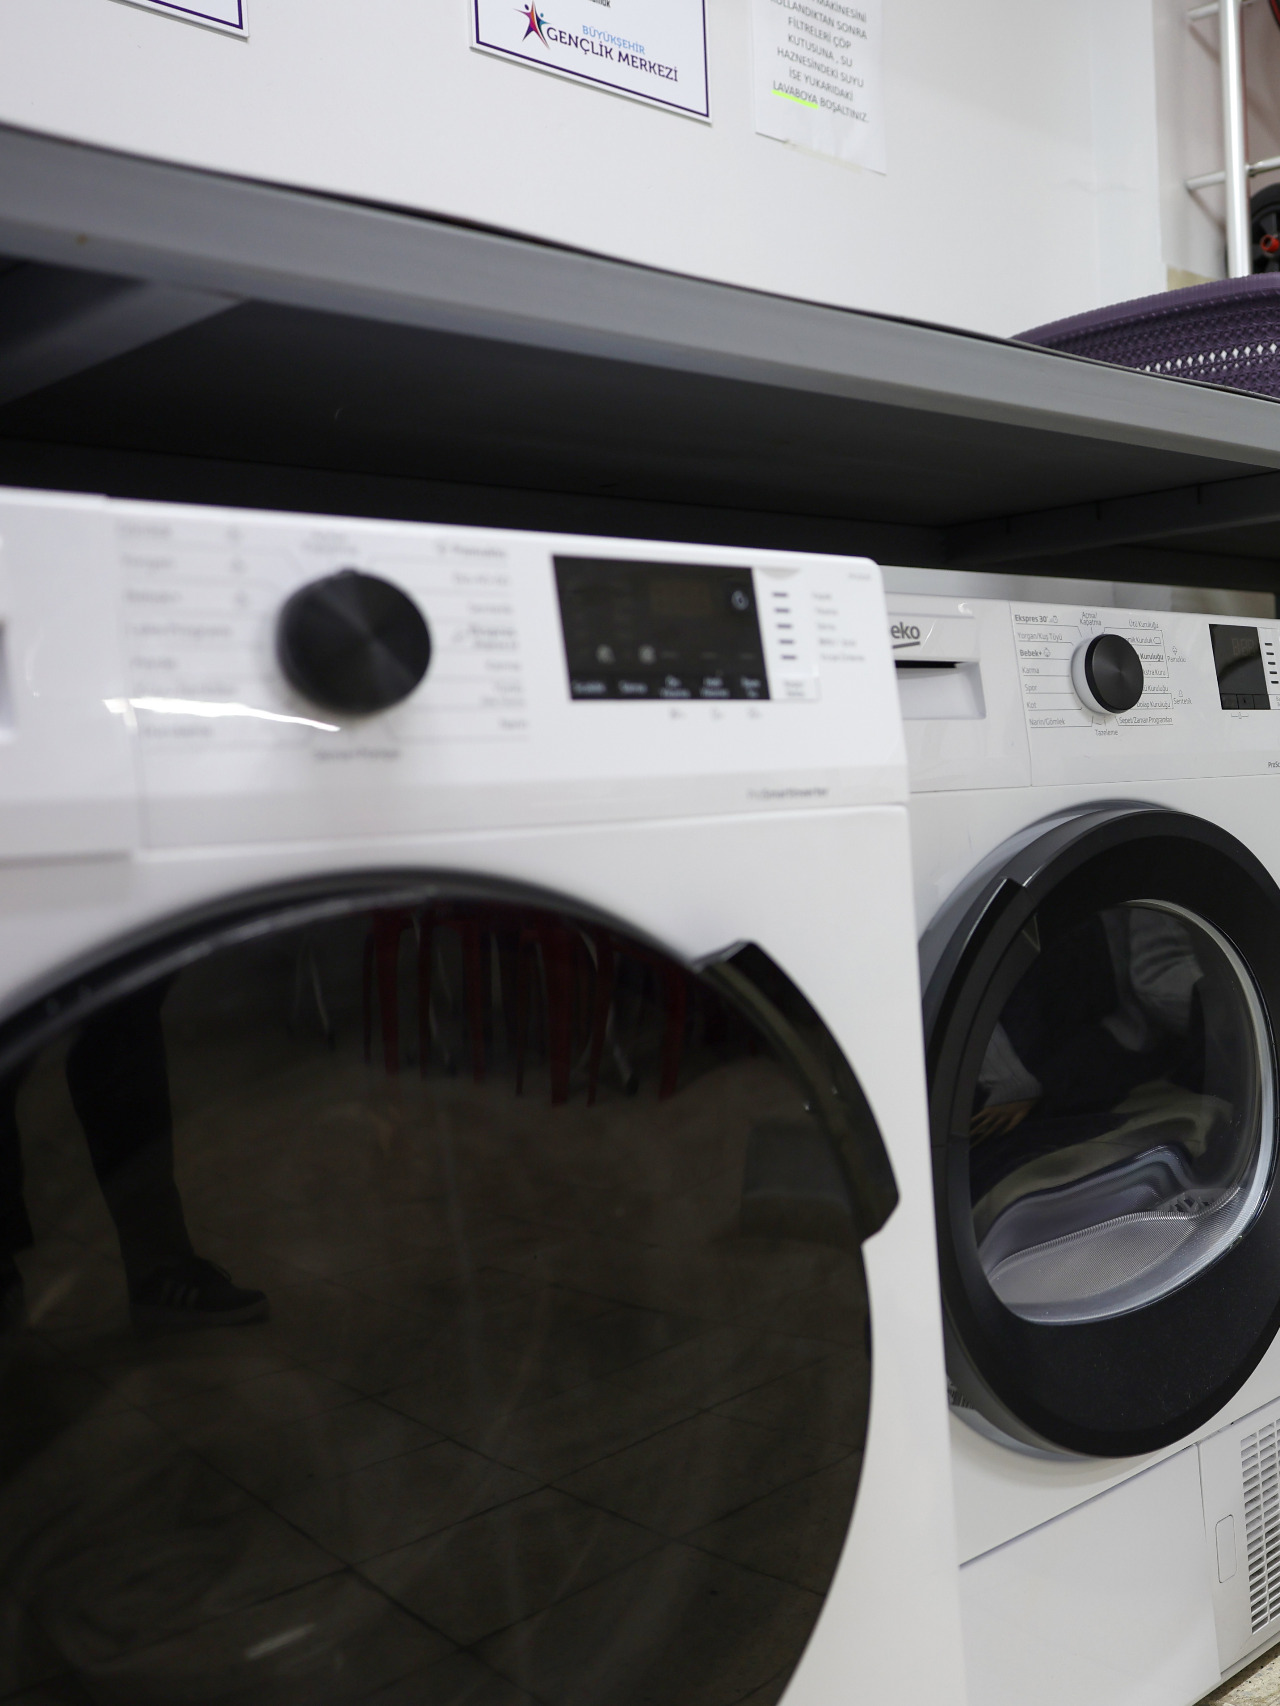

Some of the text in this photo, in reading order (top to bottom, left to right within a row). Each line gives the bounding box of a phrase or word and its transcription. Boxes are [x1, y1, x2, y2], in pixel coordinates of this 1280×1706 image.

[582, 24, 646, 55] BÜYÜKŞEHİR
[788, 16, 852, 49] FİLTRELERİ ÇÖP
[836, 19, 868, 40] SONRA
[546, 26, 679, 82] GENÇLİK MERKEZİ
[787, 33, 834, 60] KUTUSUNA
[840, 55, 853, 68] SU
[776, 46, 865, 88] HAZNESİNDEKİ SUYU
[772, 80, 819, 105] LAVABOYA
[788, 66, 854, 102] İSE YUKARIDAKİ
[890, 621, 921, 640] eko
[1014, 614, 1039, 624] Ekspres
